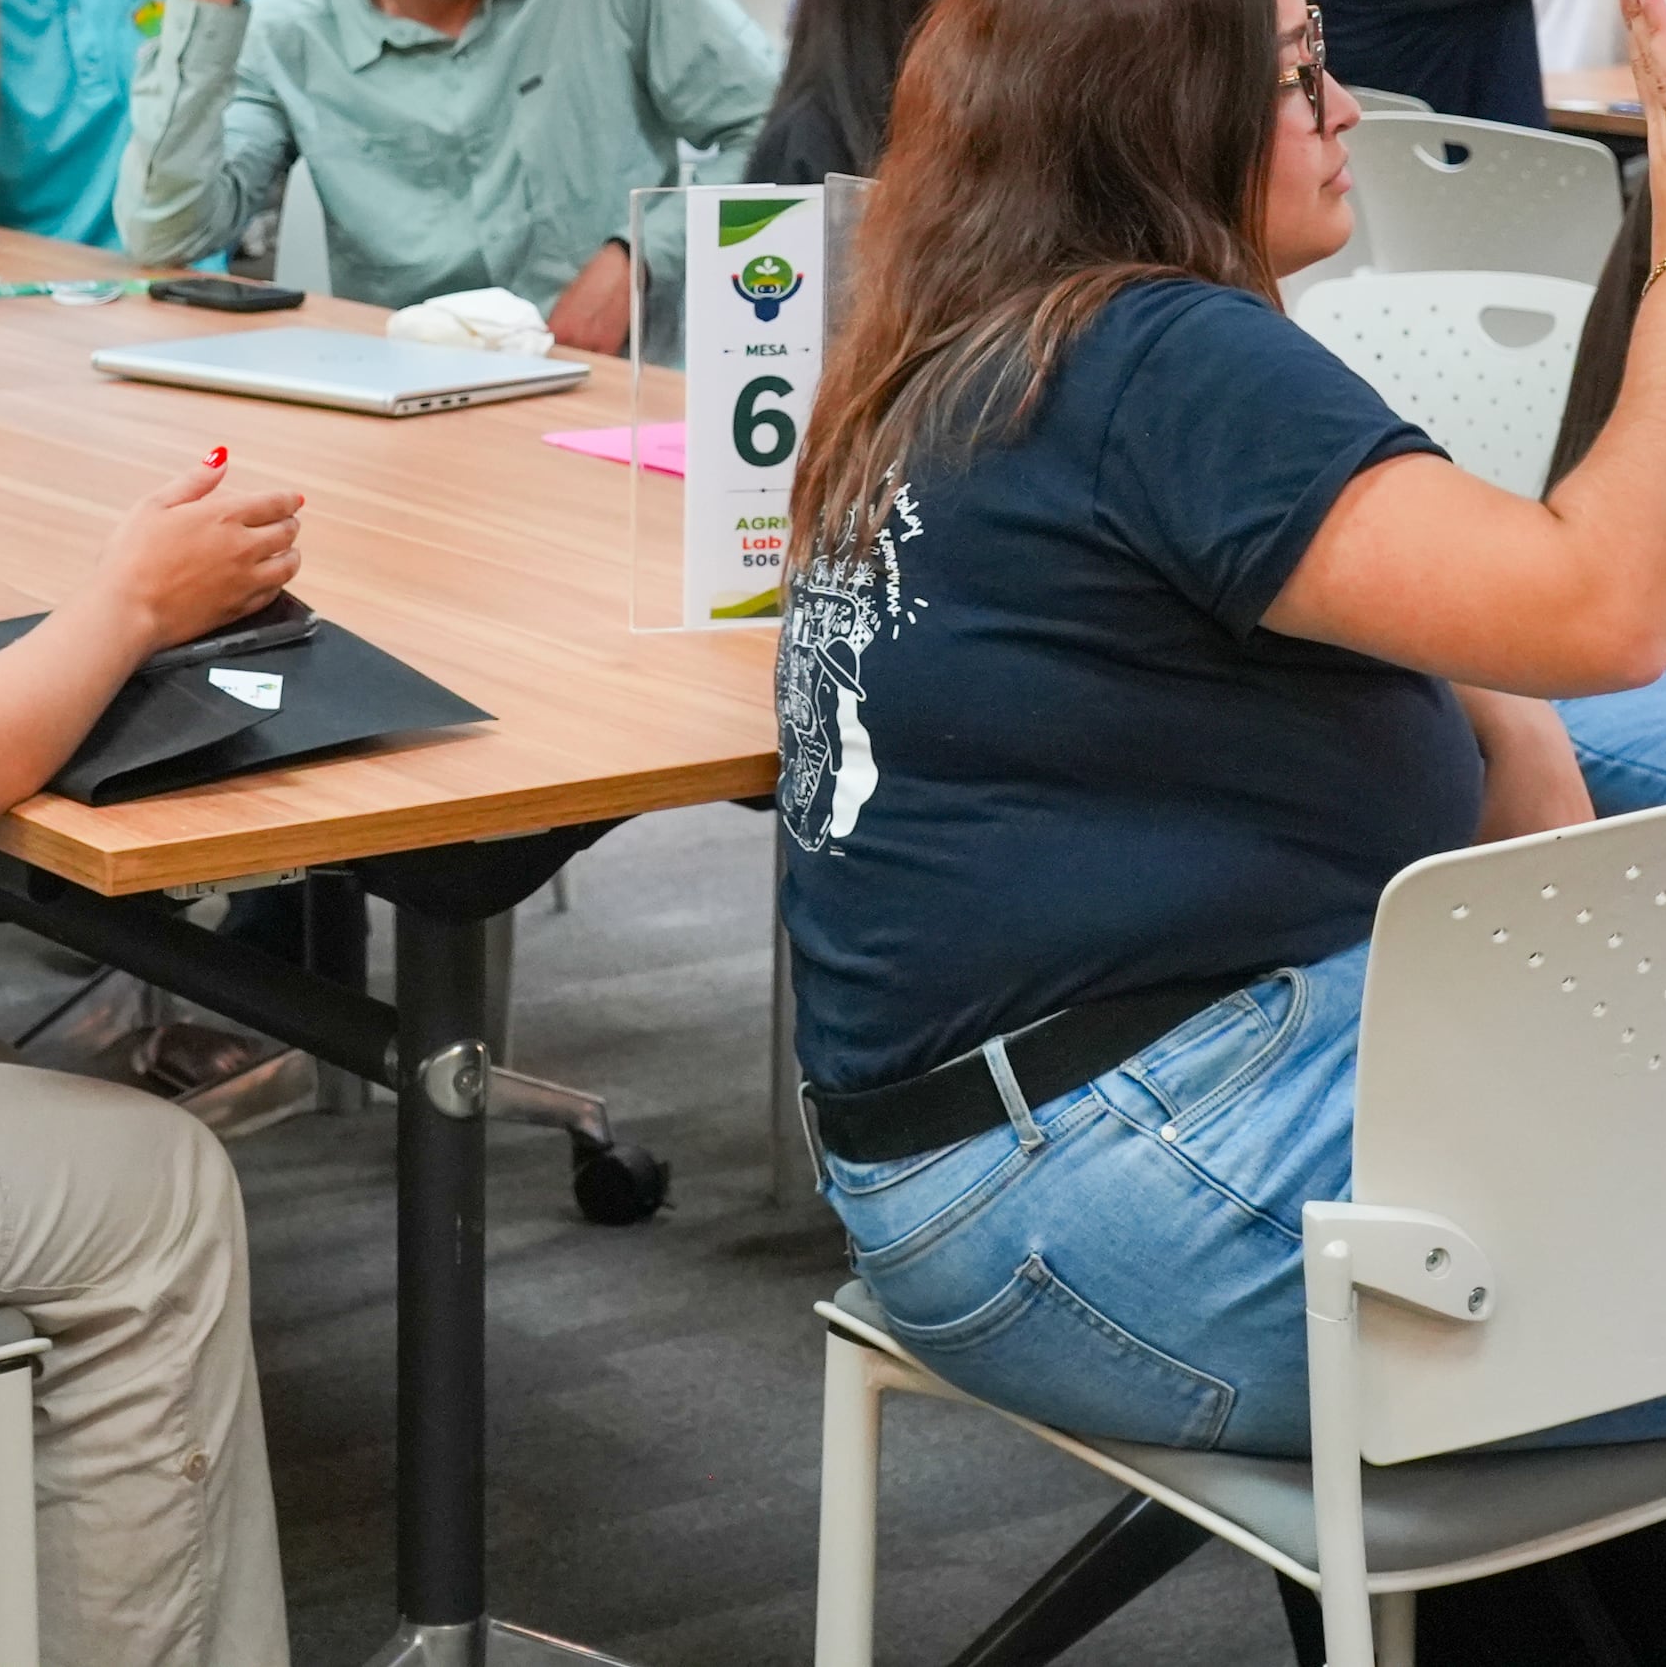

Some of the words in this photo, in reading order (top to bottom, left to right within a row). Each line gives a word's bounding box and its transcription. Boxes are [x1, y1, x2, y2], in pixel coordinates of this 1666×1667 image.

[745, 343, 788, 357] MESA
[732, 374, 797, 468] 6
[892, 482, 925, 543] today
[741, 536, 784, 551] Lab
[742, 554, 781, 568] 506
[874, 527, 902, 618] tomorrow
